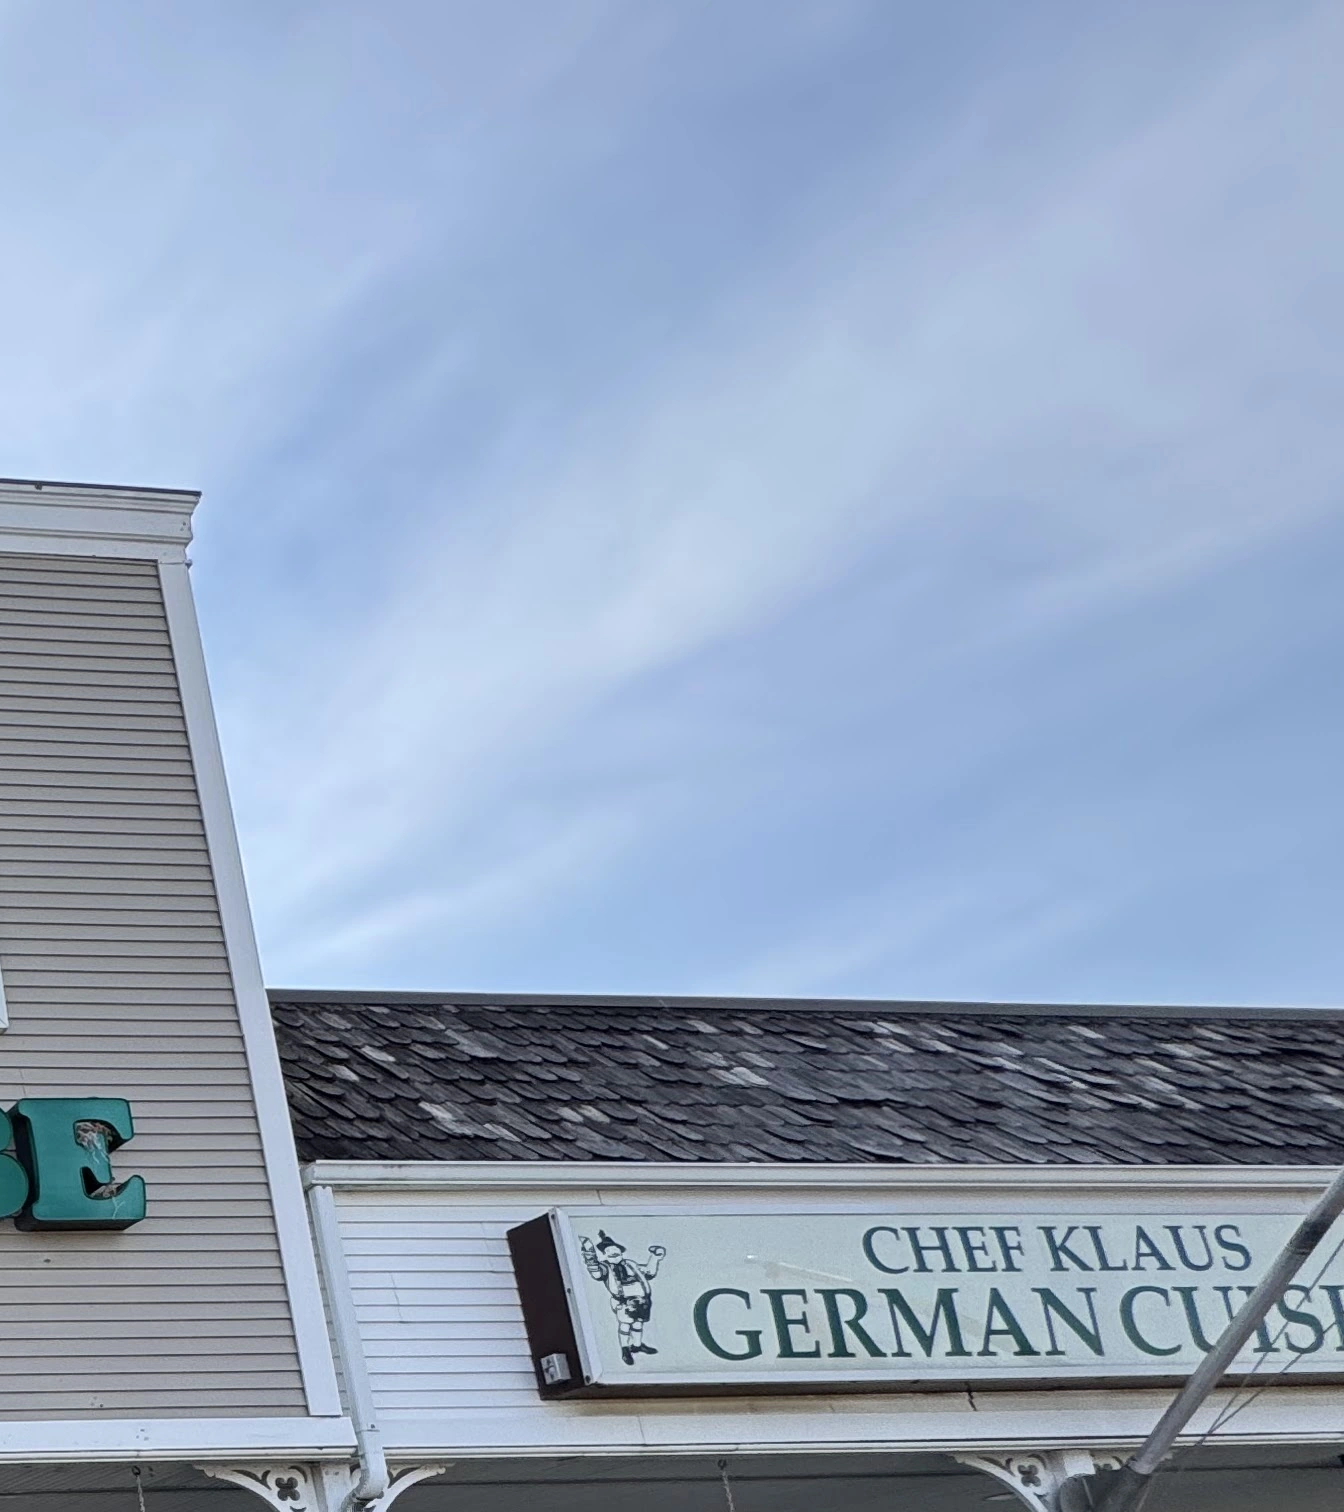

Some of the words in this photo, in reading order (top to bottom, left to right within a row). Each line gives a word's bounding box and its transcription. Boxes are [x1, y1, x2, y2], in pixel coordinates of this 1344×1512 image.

[862, 1224, 1030, 1275] CHEF
[1037, 1223, 1252, 1272] KLAUS
[693, 1286, 1105, 1359] GERMAN
